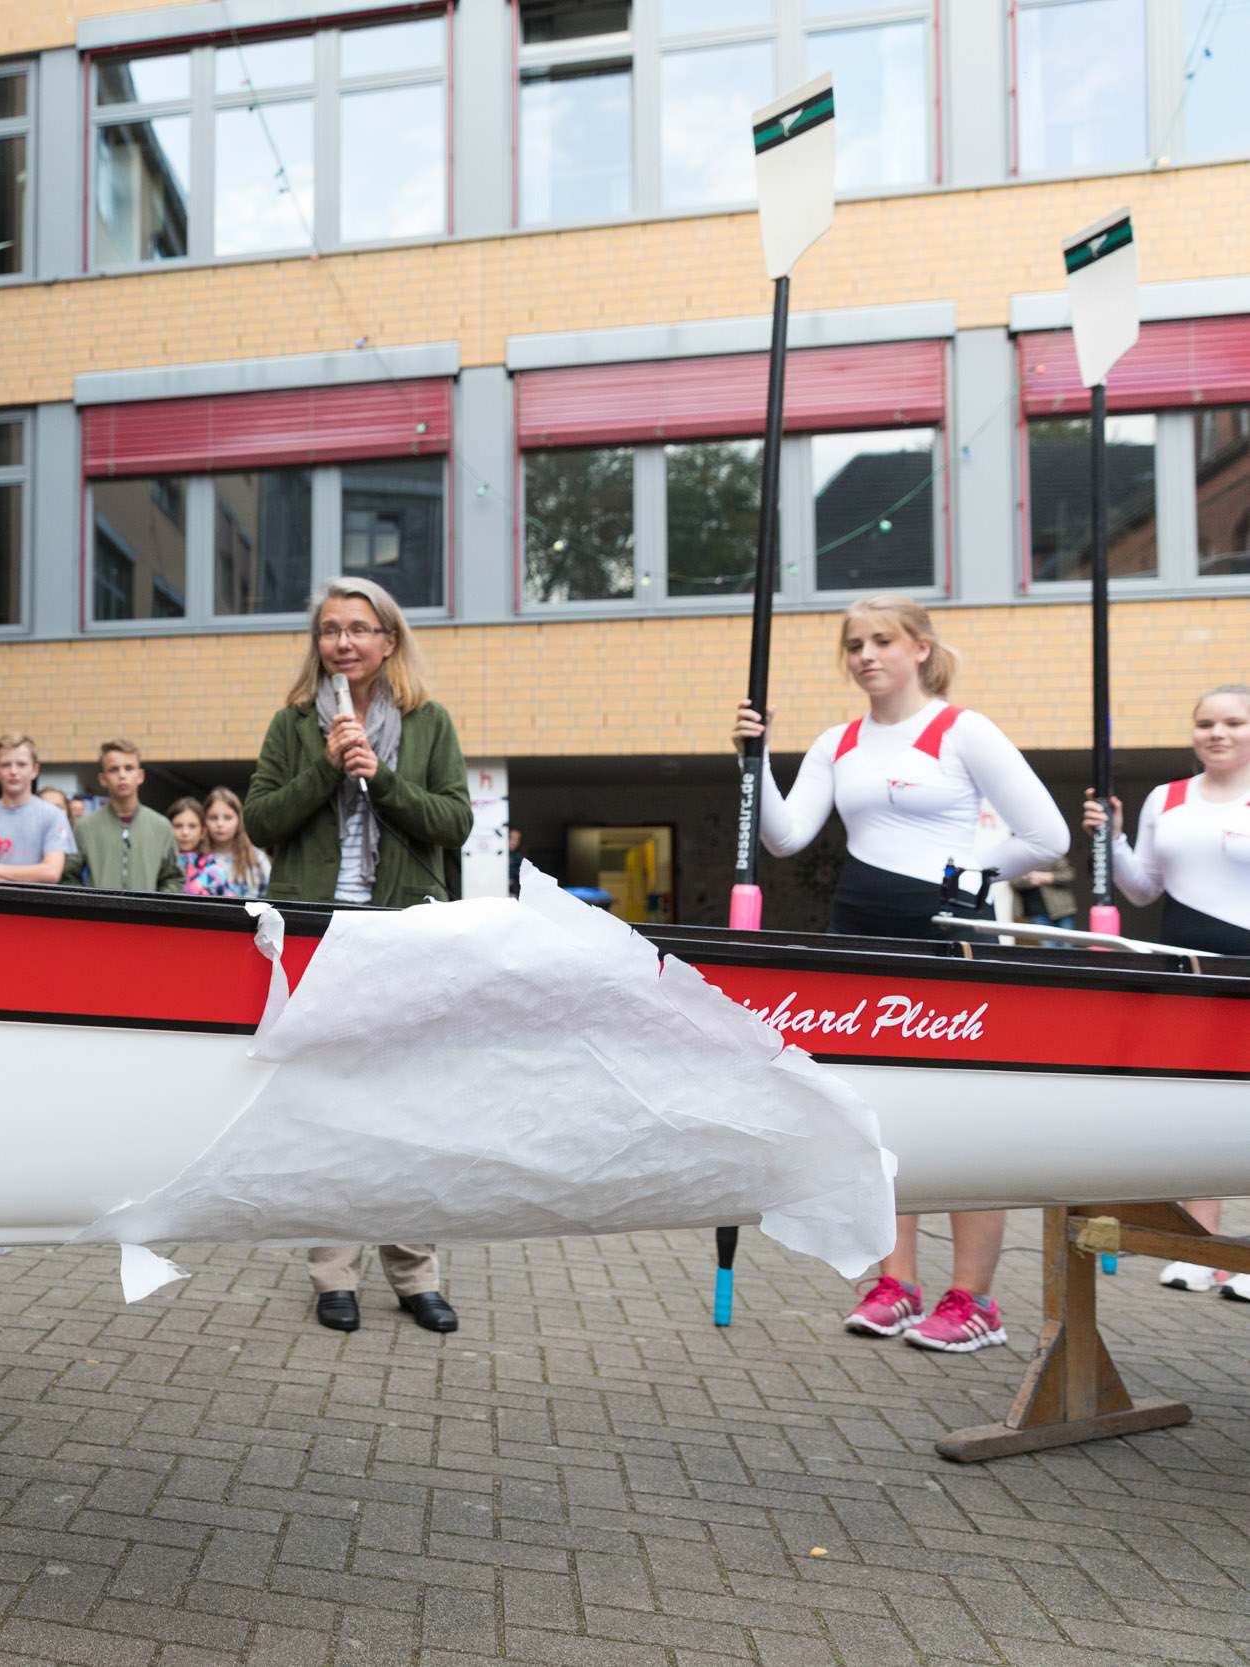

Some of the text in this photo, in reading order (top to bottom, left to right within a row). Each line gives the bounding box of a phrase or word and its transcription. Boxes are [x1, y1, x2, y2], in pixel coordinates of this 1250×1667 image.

[735, 772, 755, 870] besselrc.de
[1092, 823, 1108, 894] besselrc.
[710, 984, 989, 1041] nhard Plieth
